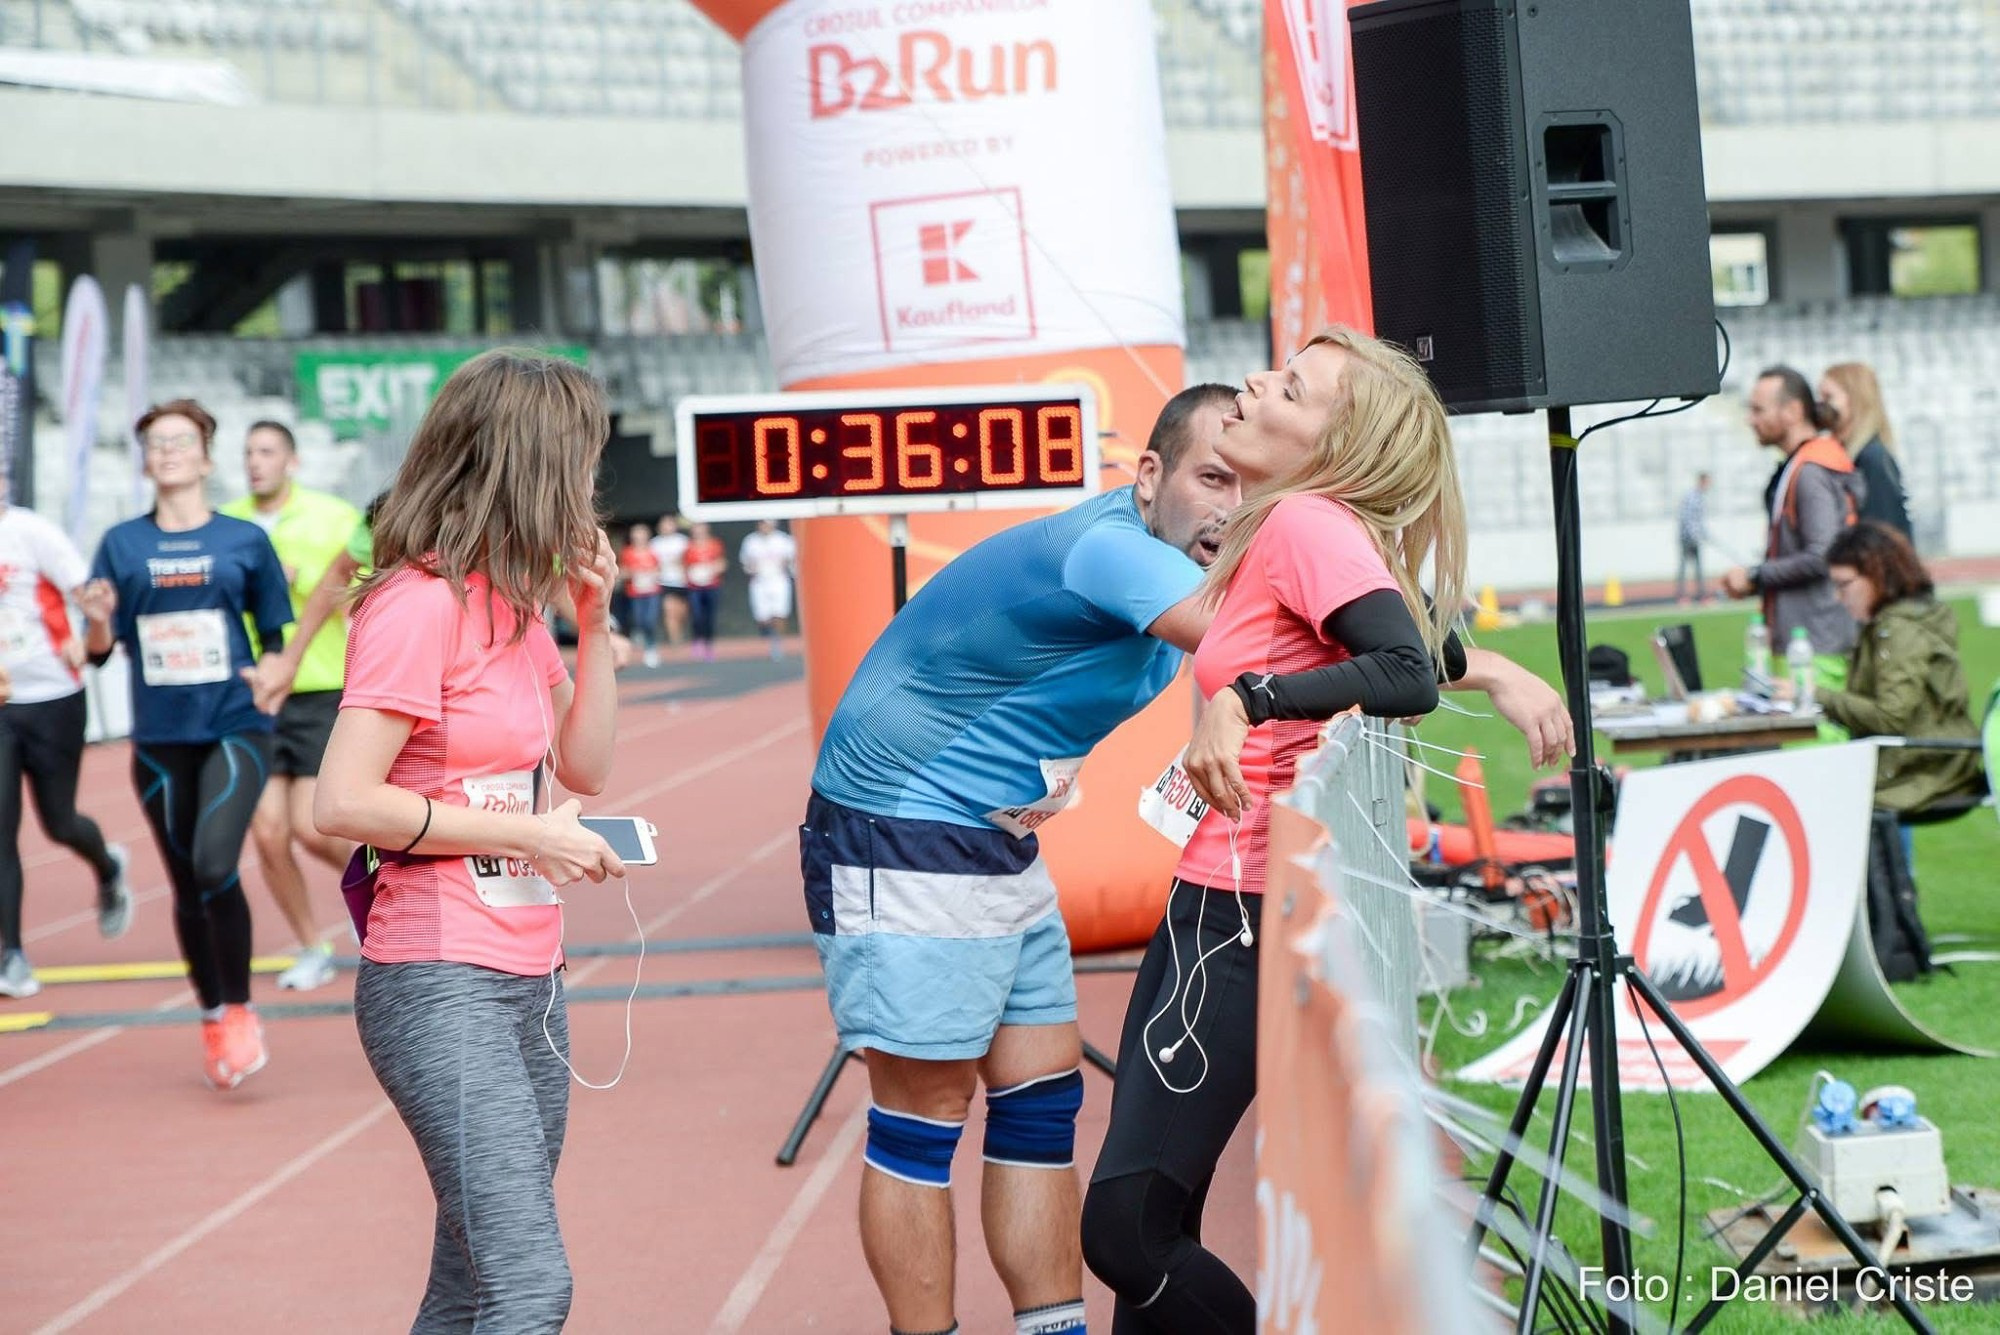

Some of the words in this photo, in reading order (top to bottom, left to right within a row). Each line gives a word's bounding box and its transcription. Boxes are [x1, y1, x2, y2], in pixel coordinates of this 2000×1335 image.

[803, 8, 883, 38] CROSUL
[807, 30, 1057, 119] B2Run
[862, 138, 978, 167] POWERED
[986, 135, 1014, 154] BY
[896, 293, 1016, 328] Kaufland
[317, 363, 437, 421] EXIT
[753, 405, 1084, 495] 0:36:08
